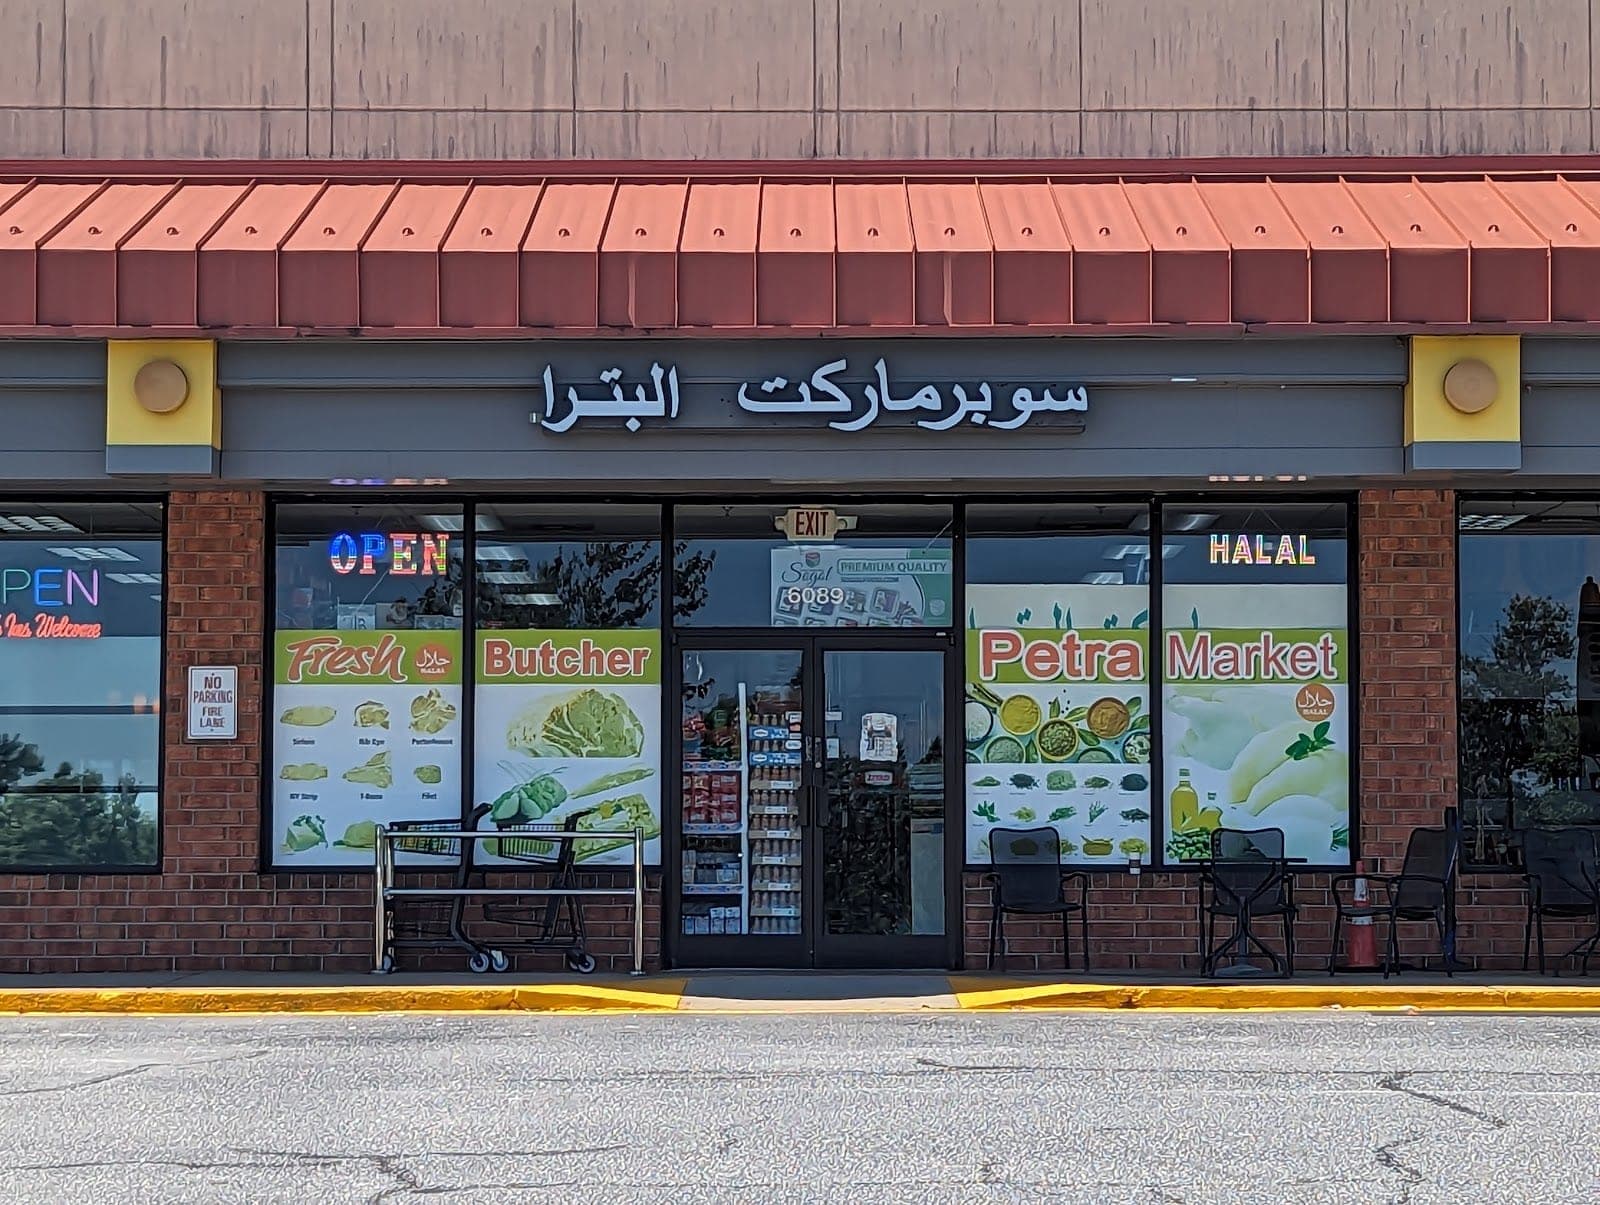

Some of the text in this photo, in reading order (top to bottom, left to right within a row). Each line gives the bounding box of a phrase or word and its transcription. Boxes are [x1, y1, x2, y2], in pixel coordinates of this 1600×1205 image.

[795, 511, 829, 536] EXIT
[329, 532, 449, 575] OPEN
[1210, 534, 1316, 565] HALAL
[840, 561, 948, 573] PREMIUM QUALITY
[788, 586, 845, 605] 6089
[35, 612, 101, 638] Welcome
[286, 634, 408, 683] Fresh
[415, 649, 451, 668] حلال
[484, 638, 651, 677] Butcher
[979, 630, 1146, 680] Petra
[1165, 630, 1338, 680] Market
[204, 676, 222, 689] NO
[193, 690, 233, 703] PARKING
[1298, 689, 1332, 708] حلال
[199, 717, 225, 729] LANE
[202, 707, 224, 717] FIRE
